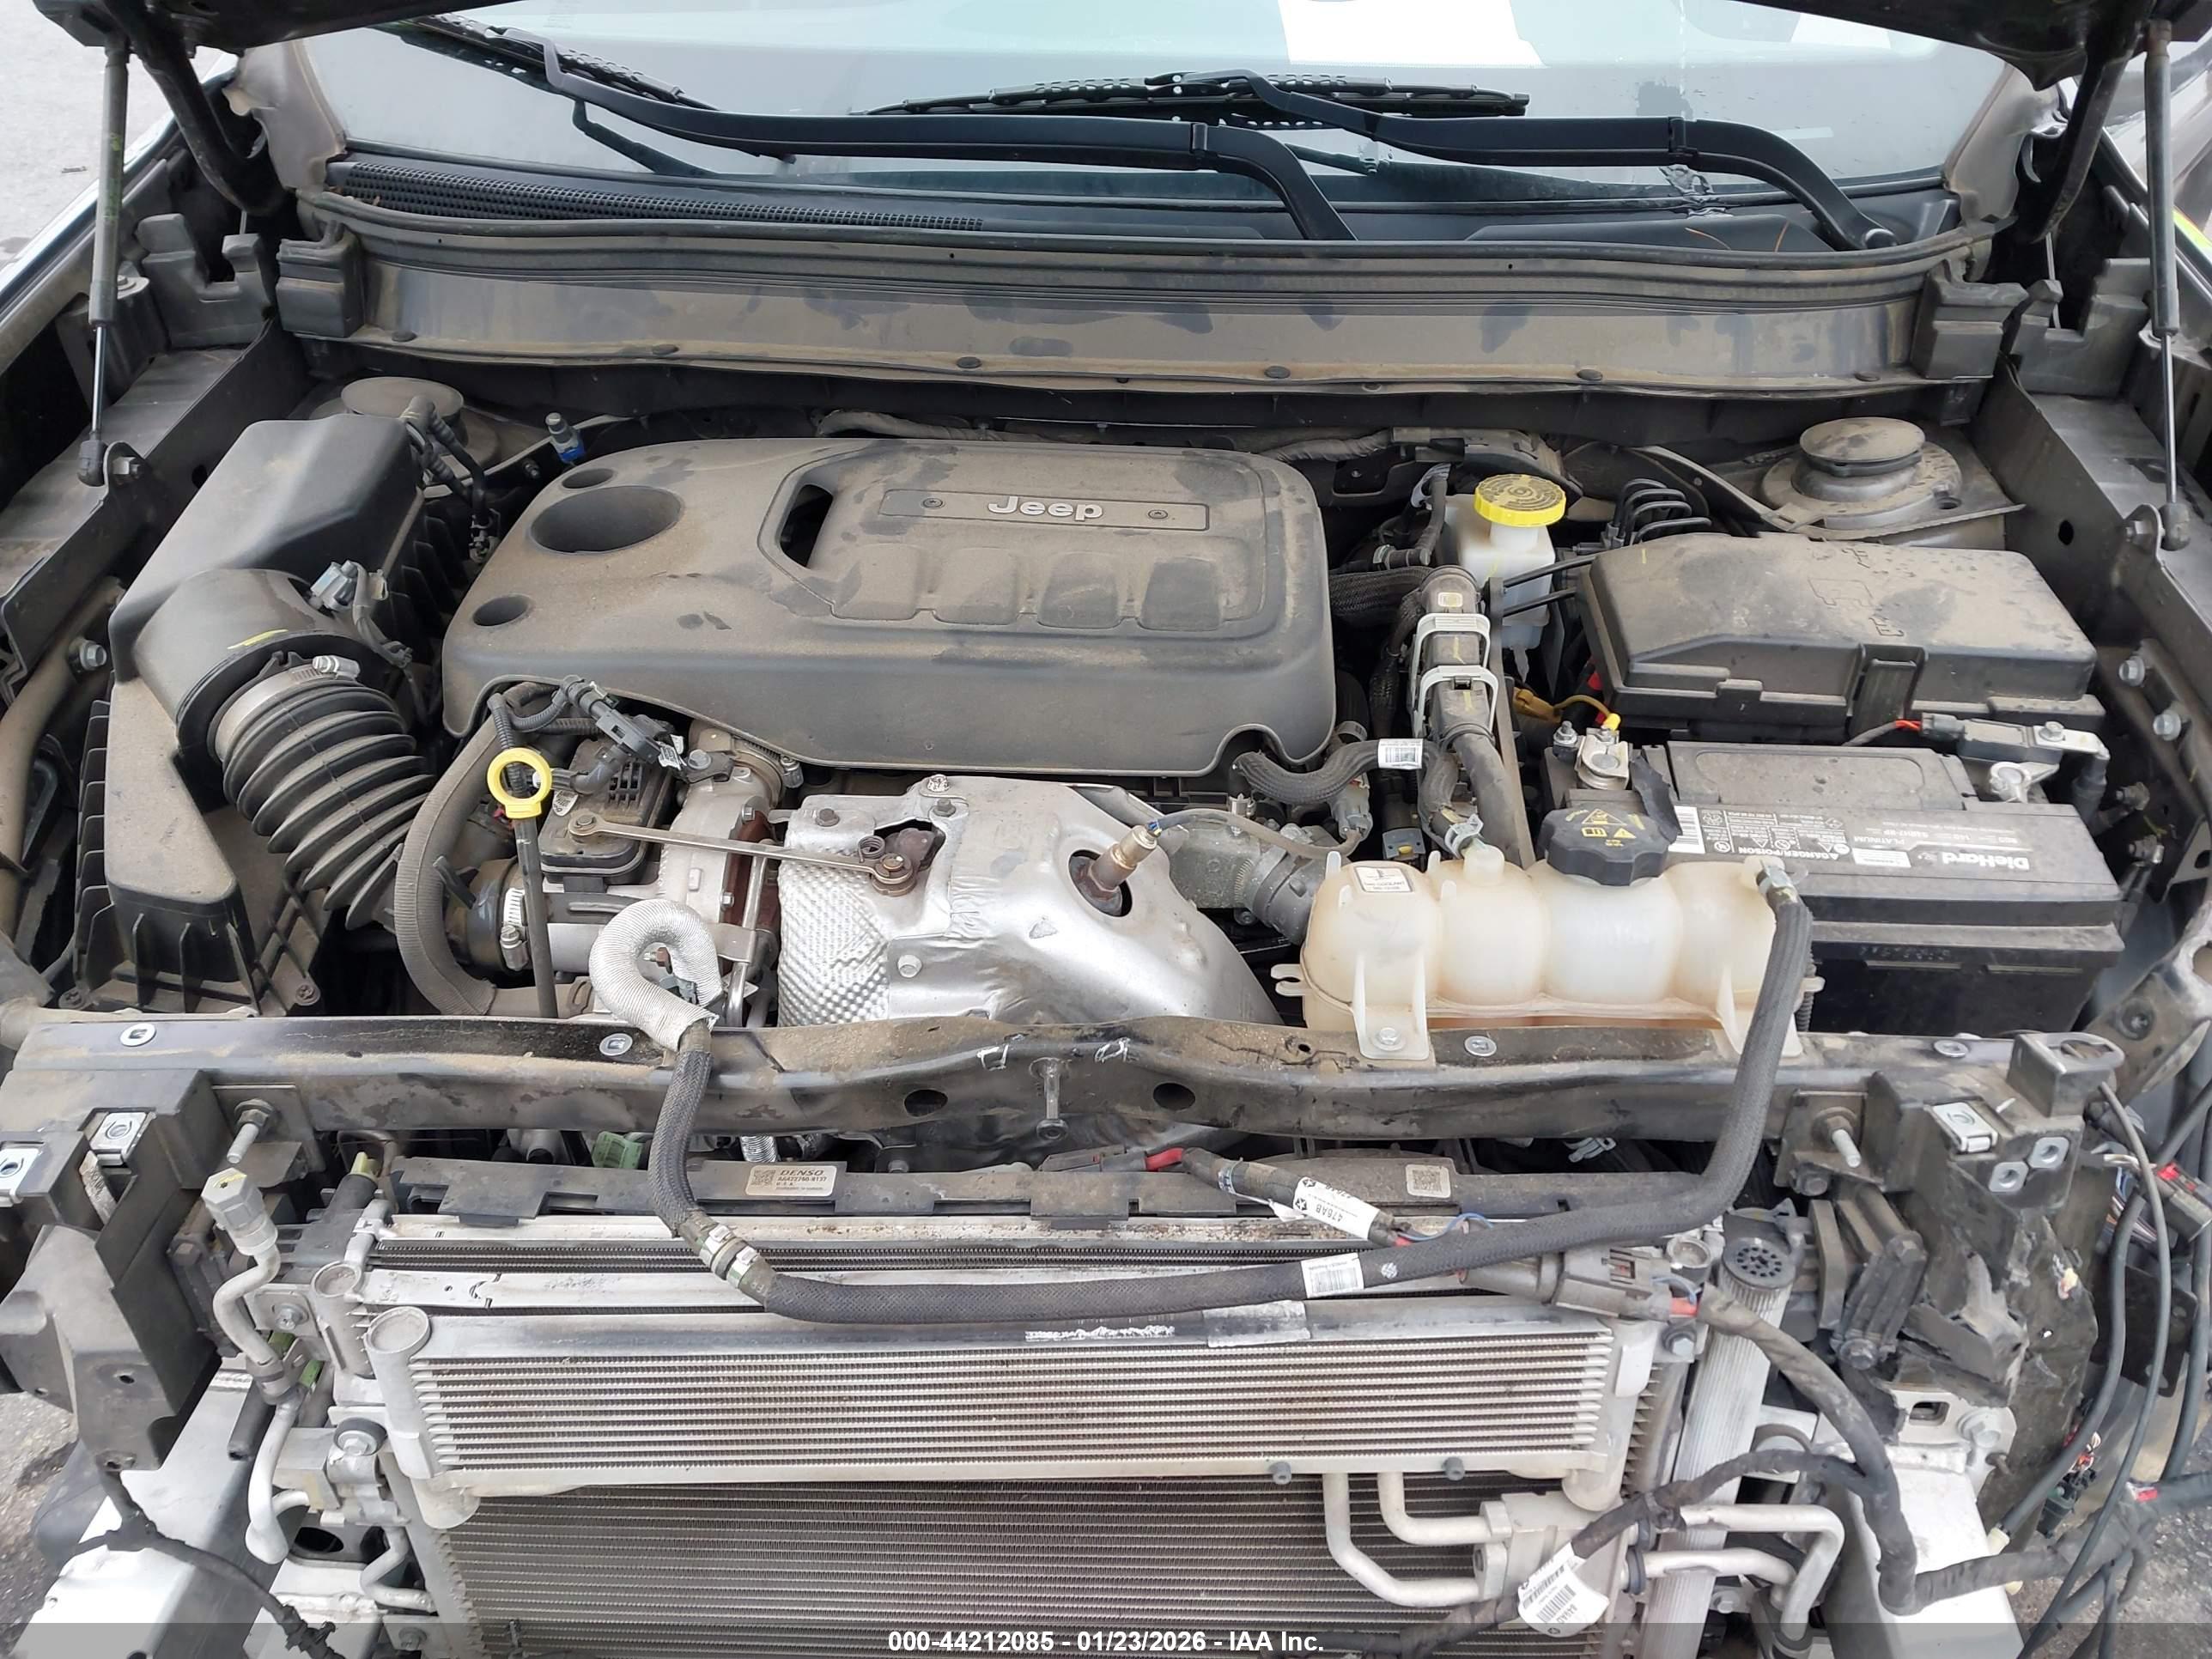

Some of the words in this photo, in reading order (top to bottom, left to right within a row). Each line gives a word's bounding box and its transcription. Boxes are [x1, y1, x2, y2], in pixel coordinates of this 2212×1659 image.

[988, 495, 1103, 522] Jeep
[1738, 847, 1832, 860] DANGER/POISON
[1942, 851, 2030, 870] DieHard
